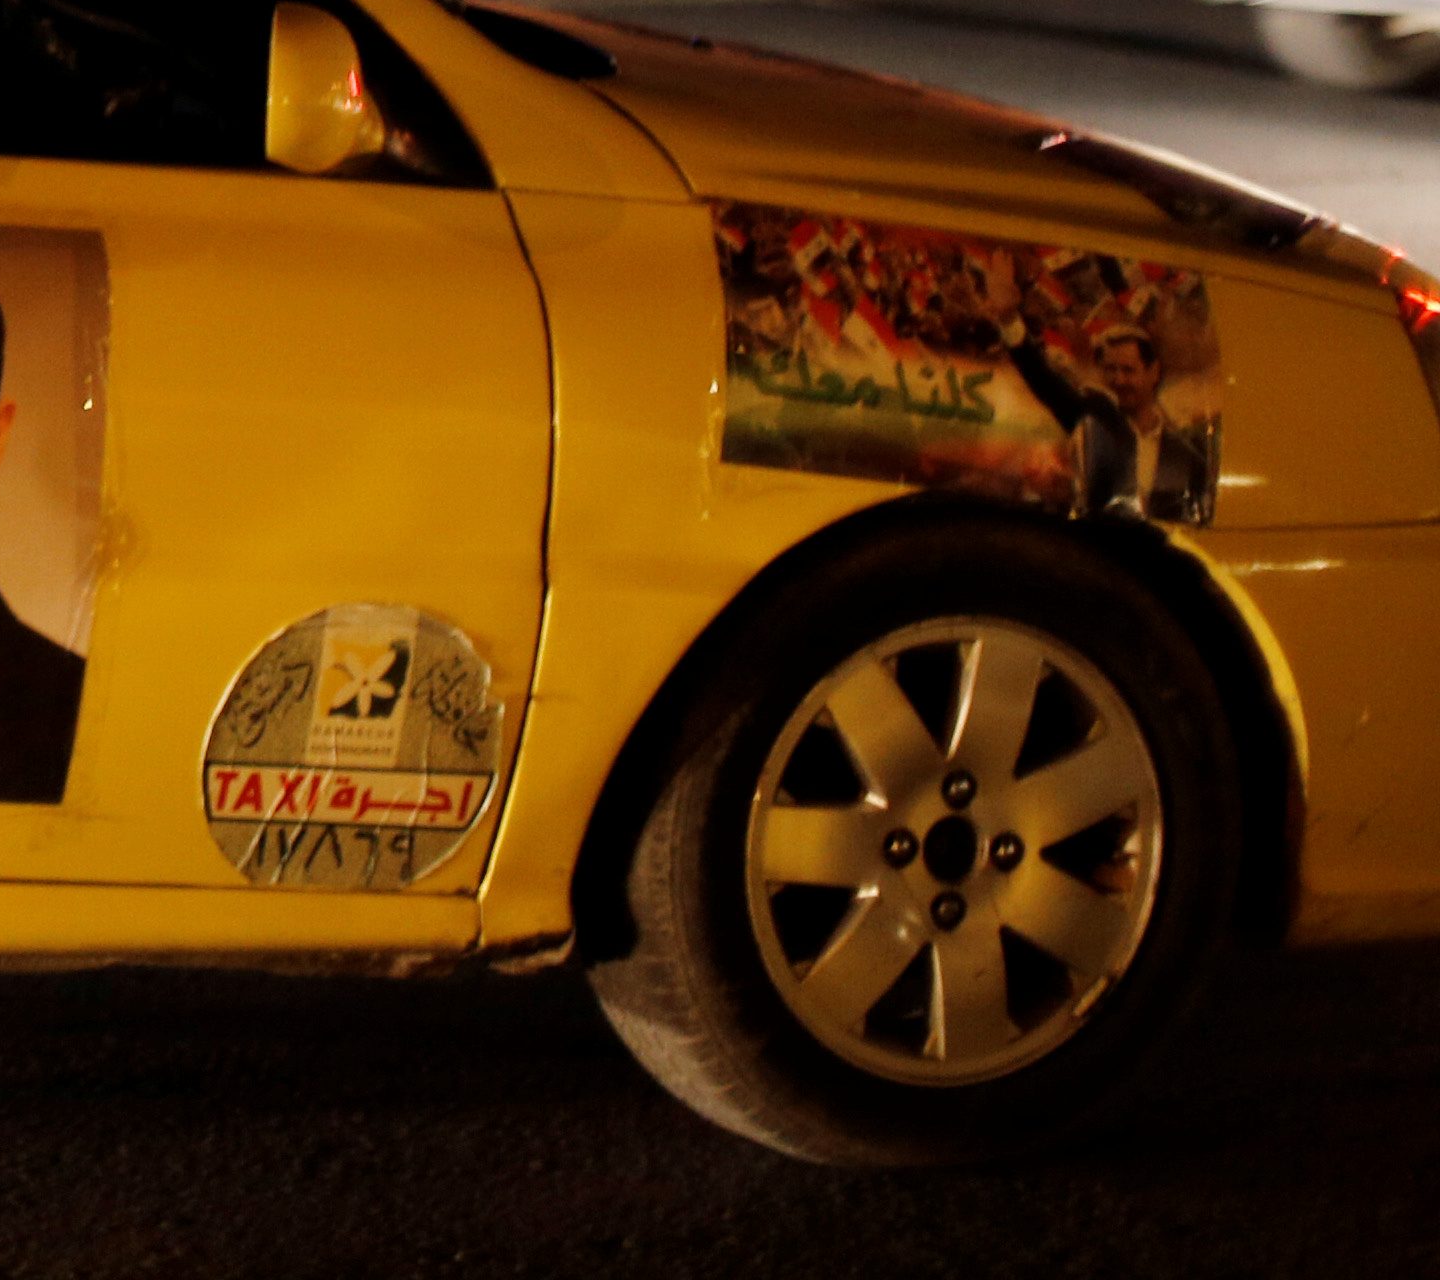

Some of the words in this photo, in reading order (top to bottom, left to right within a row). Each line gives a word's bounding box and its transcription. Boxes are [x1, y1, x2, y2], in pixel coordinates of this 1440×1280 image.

[737, 345, 881, 408] معك
[895, 360, 996, 425] كلنا
[214, 770, 322, 814] TAXI
[329, 777, 475, 821] اجرة
[256, 825, 416, 887] ١٧٨٦٩
